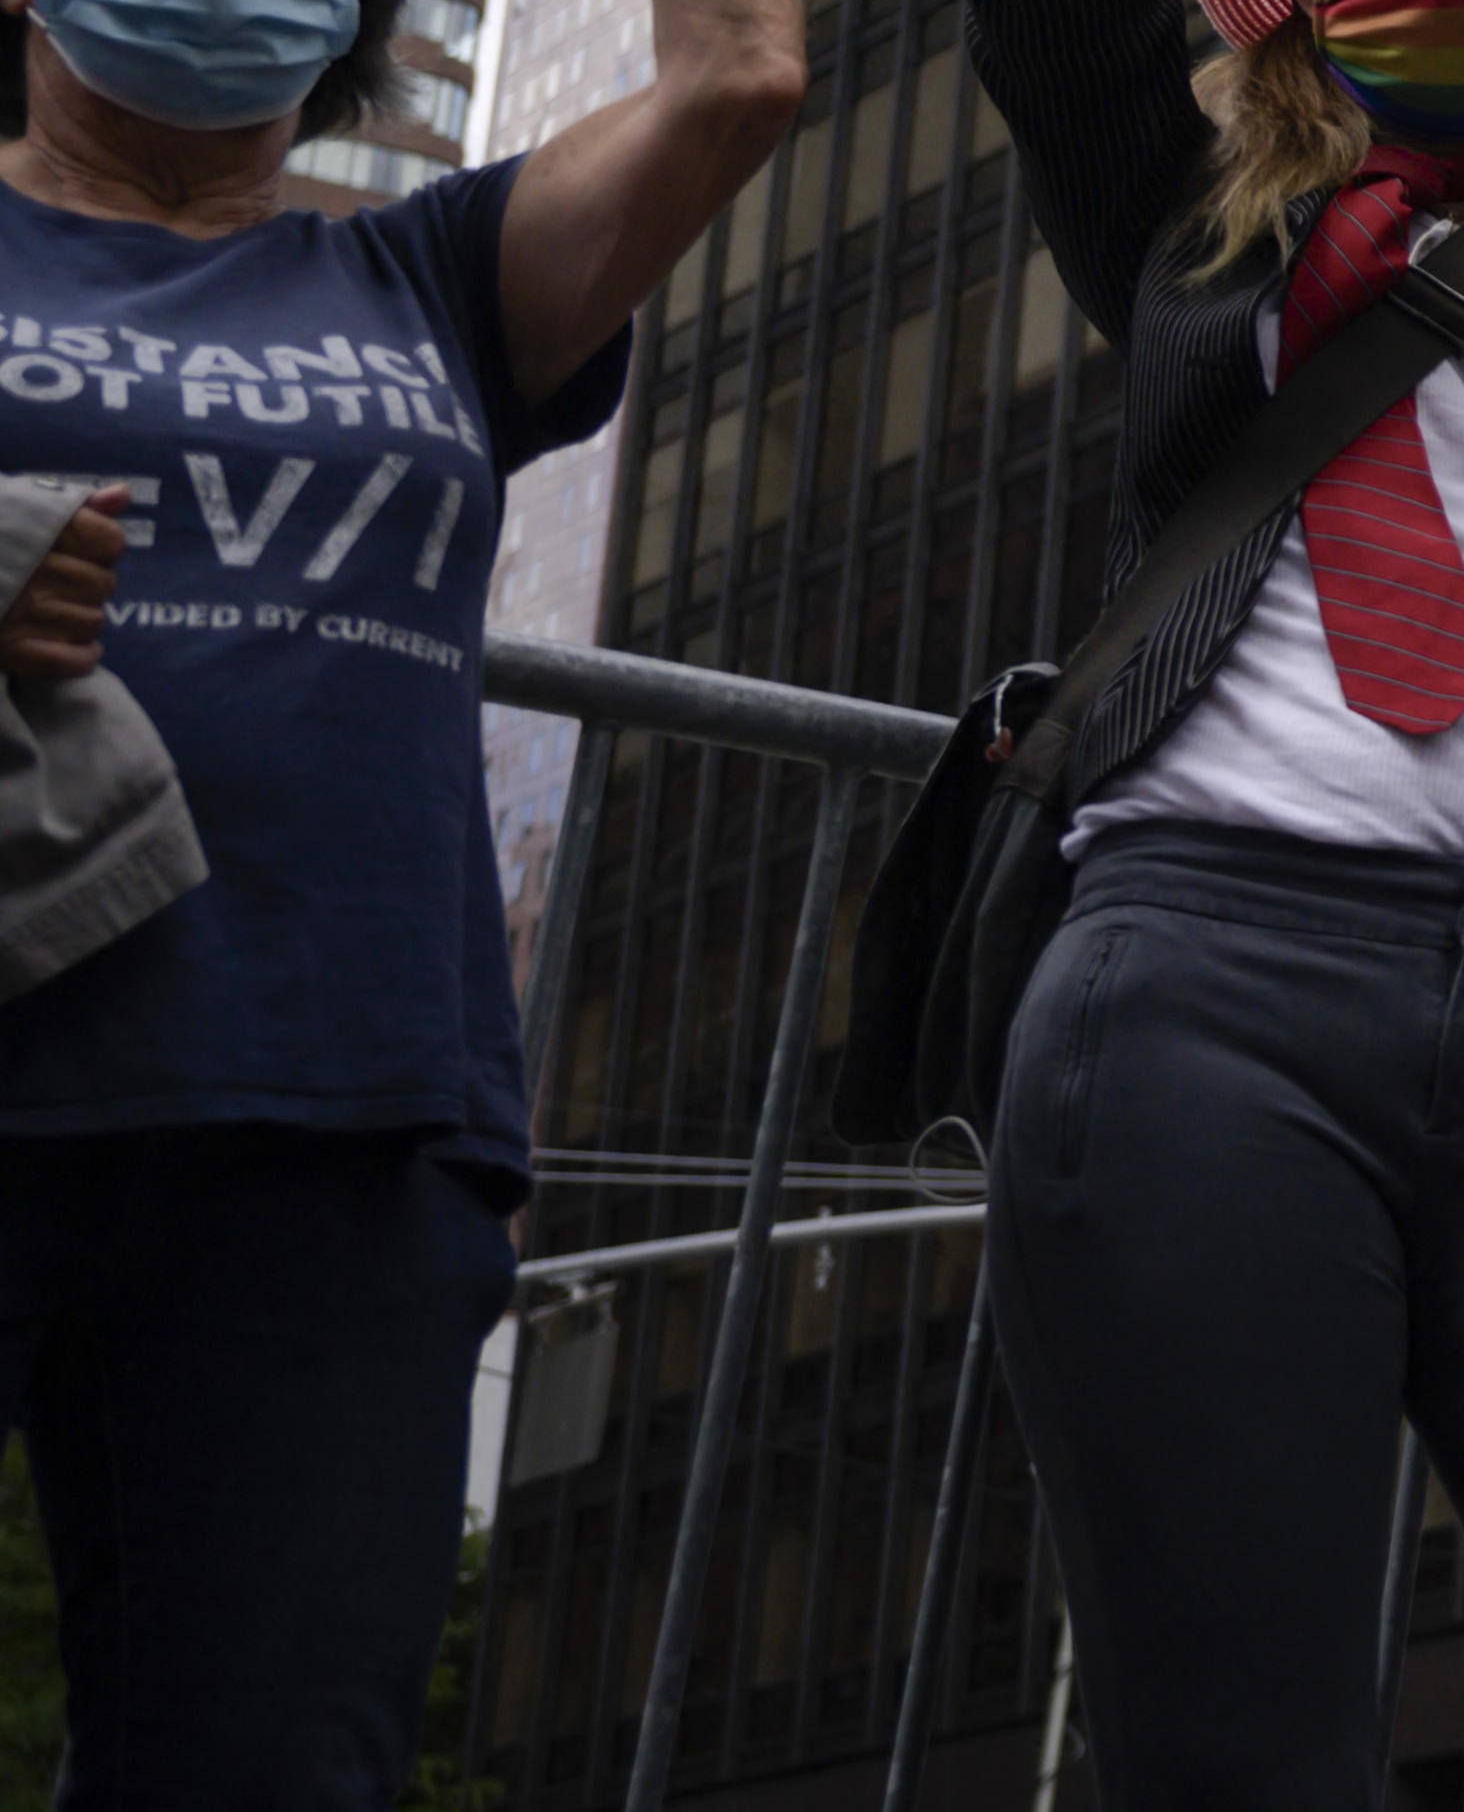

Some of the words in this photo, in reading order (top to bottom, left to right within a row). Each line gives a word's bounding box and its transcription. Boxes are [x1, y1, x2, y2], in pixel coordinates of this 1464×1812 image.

[0, 354, 143, 411] OT
[182, 380, 487, 458] FUTILE
[103, 599, 242, 630] VIDED
[255, 601, 309, 634] BY
[317, 614, 465, 674] CURRENT
